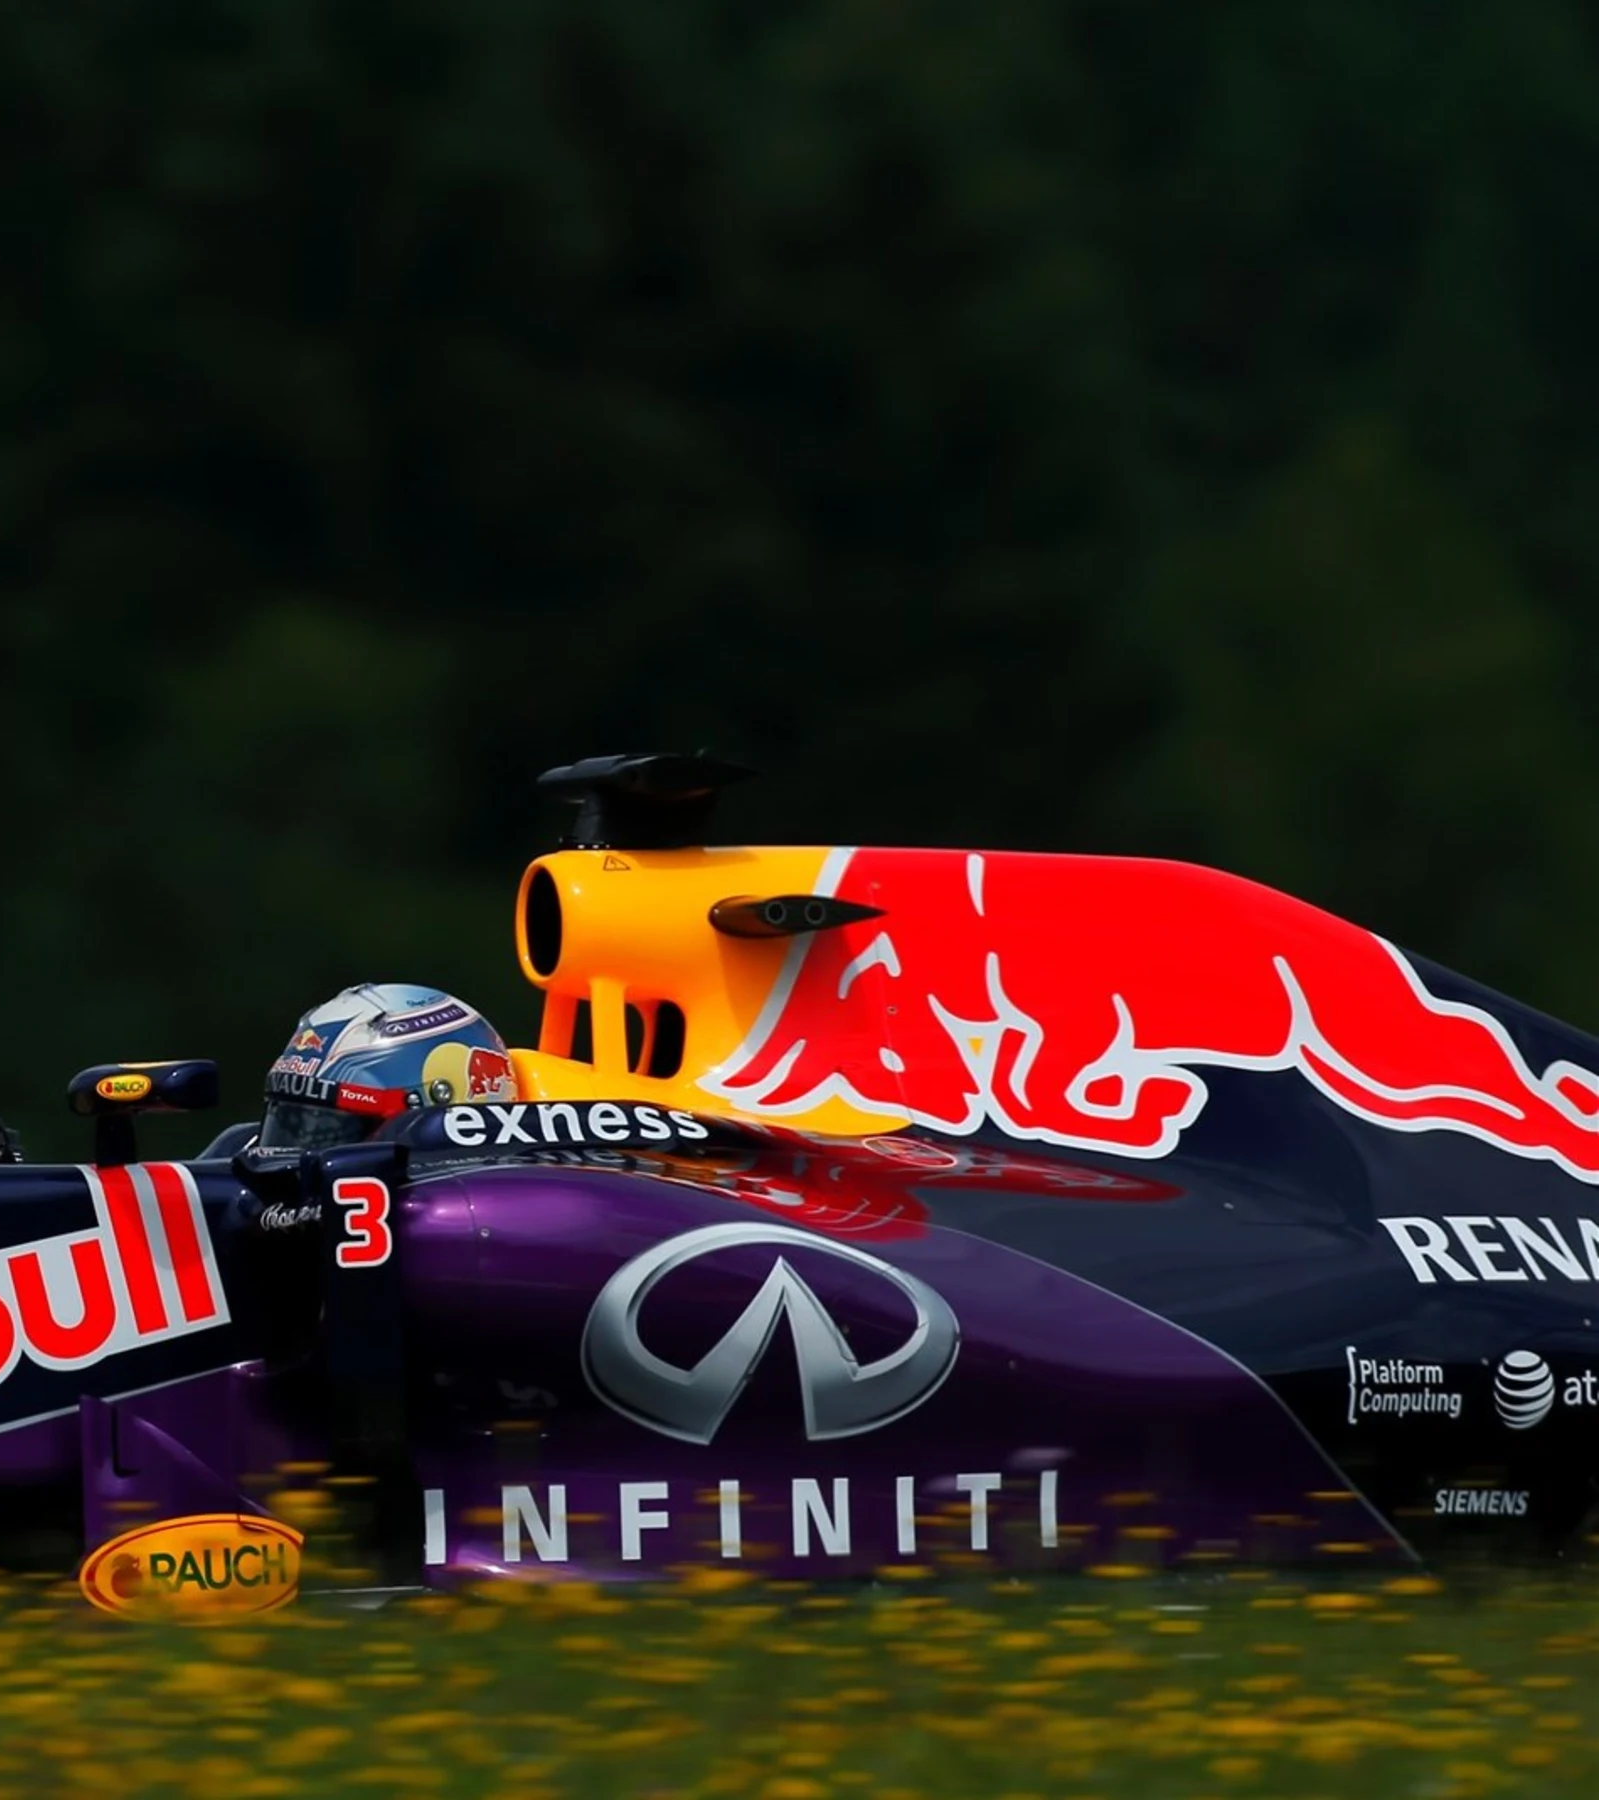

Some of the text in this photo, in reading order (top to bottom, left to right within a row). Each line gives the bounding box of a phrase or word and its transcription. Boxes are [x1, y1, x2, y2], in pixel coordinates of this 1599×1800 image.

[340, 1089, 378, 1104] TOTAL
[443, 1102, 710, 1146] exness
[333, 1177, 392, 1268] 3
[1359, 1360, 1444, 1384] Platform
[1563, 1370, 1599, 1405] at
[1359, 1388, 1462, 1418] Computing
[424, 1470, 1058, 1565] INFINITI
[1434, 1489, 1529, 1516] SIEMENS
[149, 1543, 288, 1593] RAUCH
